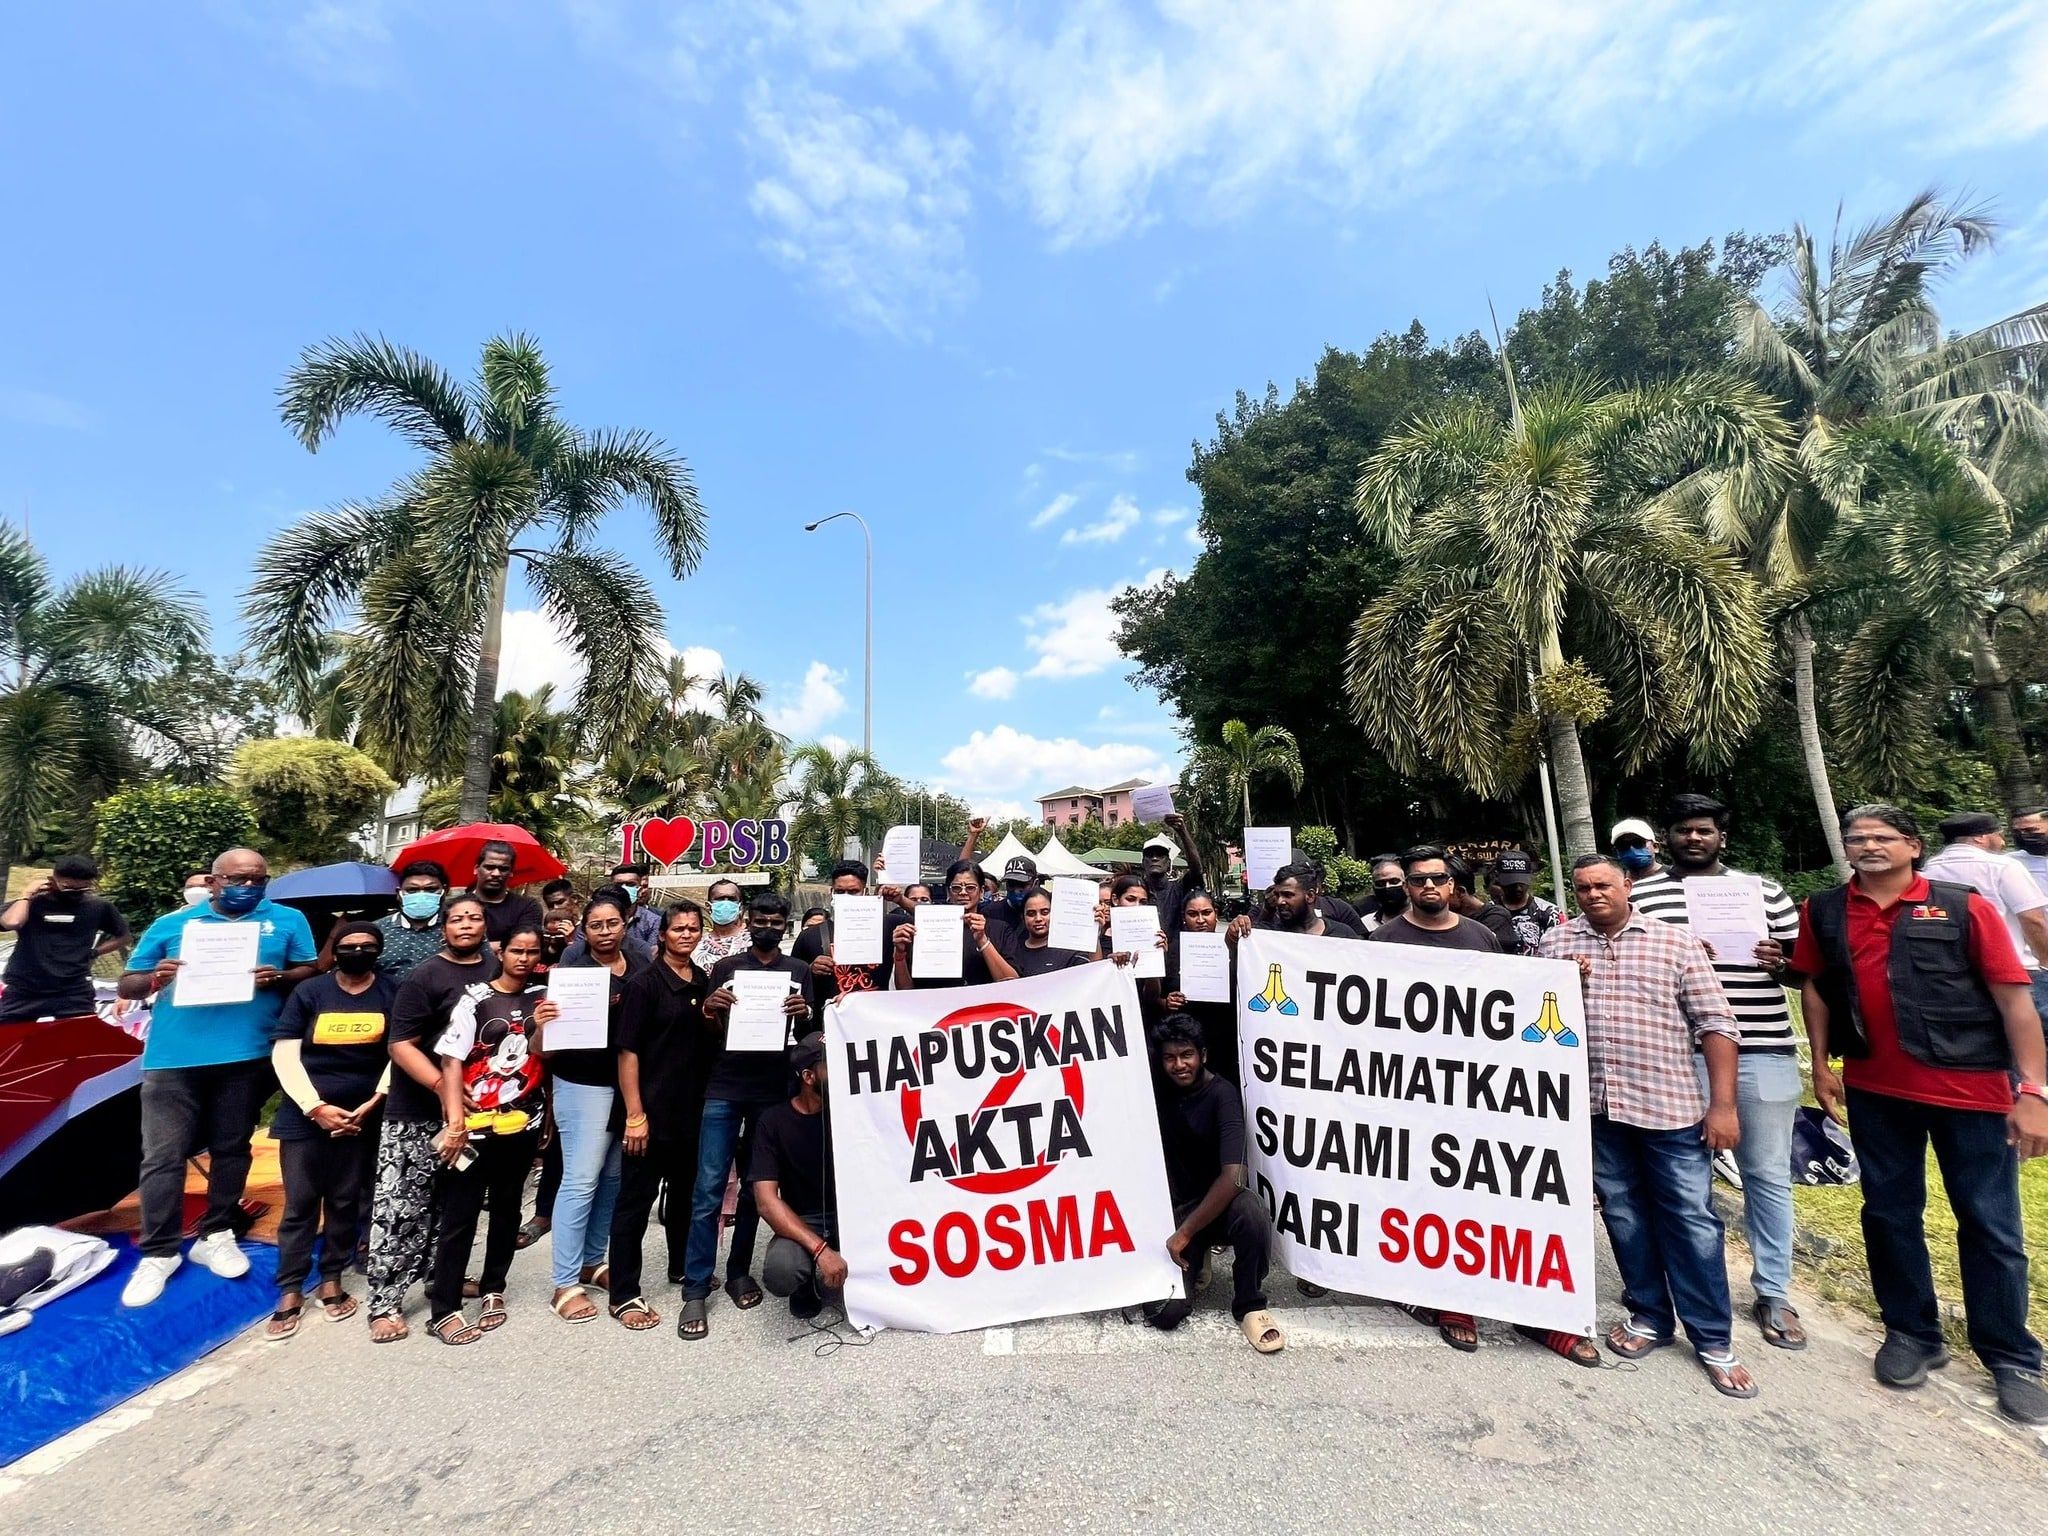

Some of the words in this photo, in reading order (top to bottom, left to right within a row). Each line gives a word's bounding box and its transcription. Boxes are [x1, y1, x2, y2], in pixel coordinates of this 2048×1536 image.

[619, 823, 639, 866] I
[699, 818, 791, 868] PSB
[1306, 970, 1515, 1041] TOLONG
[846, 1004, 1128, 1095] HAPUSKAN
[1253, 1037, 1570, 1122] SELAMATKAN
[909, 1098, 1093, 1183] AKTA
[1255, 1106, 1410, 1181] SUAMI
[1430, 1133, 1571, 1206] SAYA
[888, 1190, 1136, 1286] SOSMA
[1378, 1207, 1576, 1294] SOSMA
